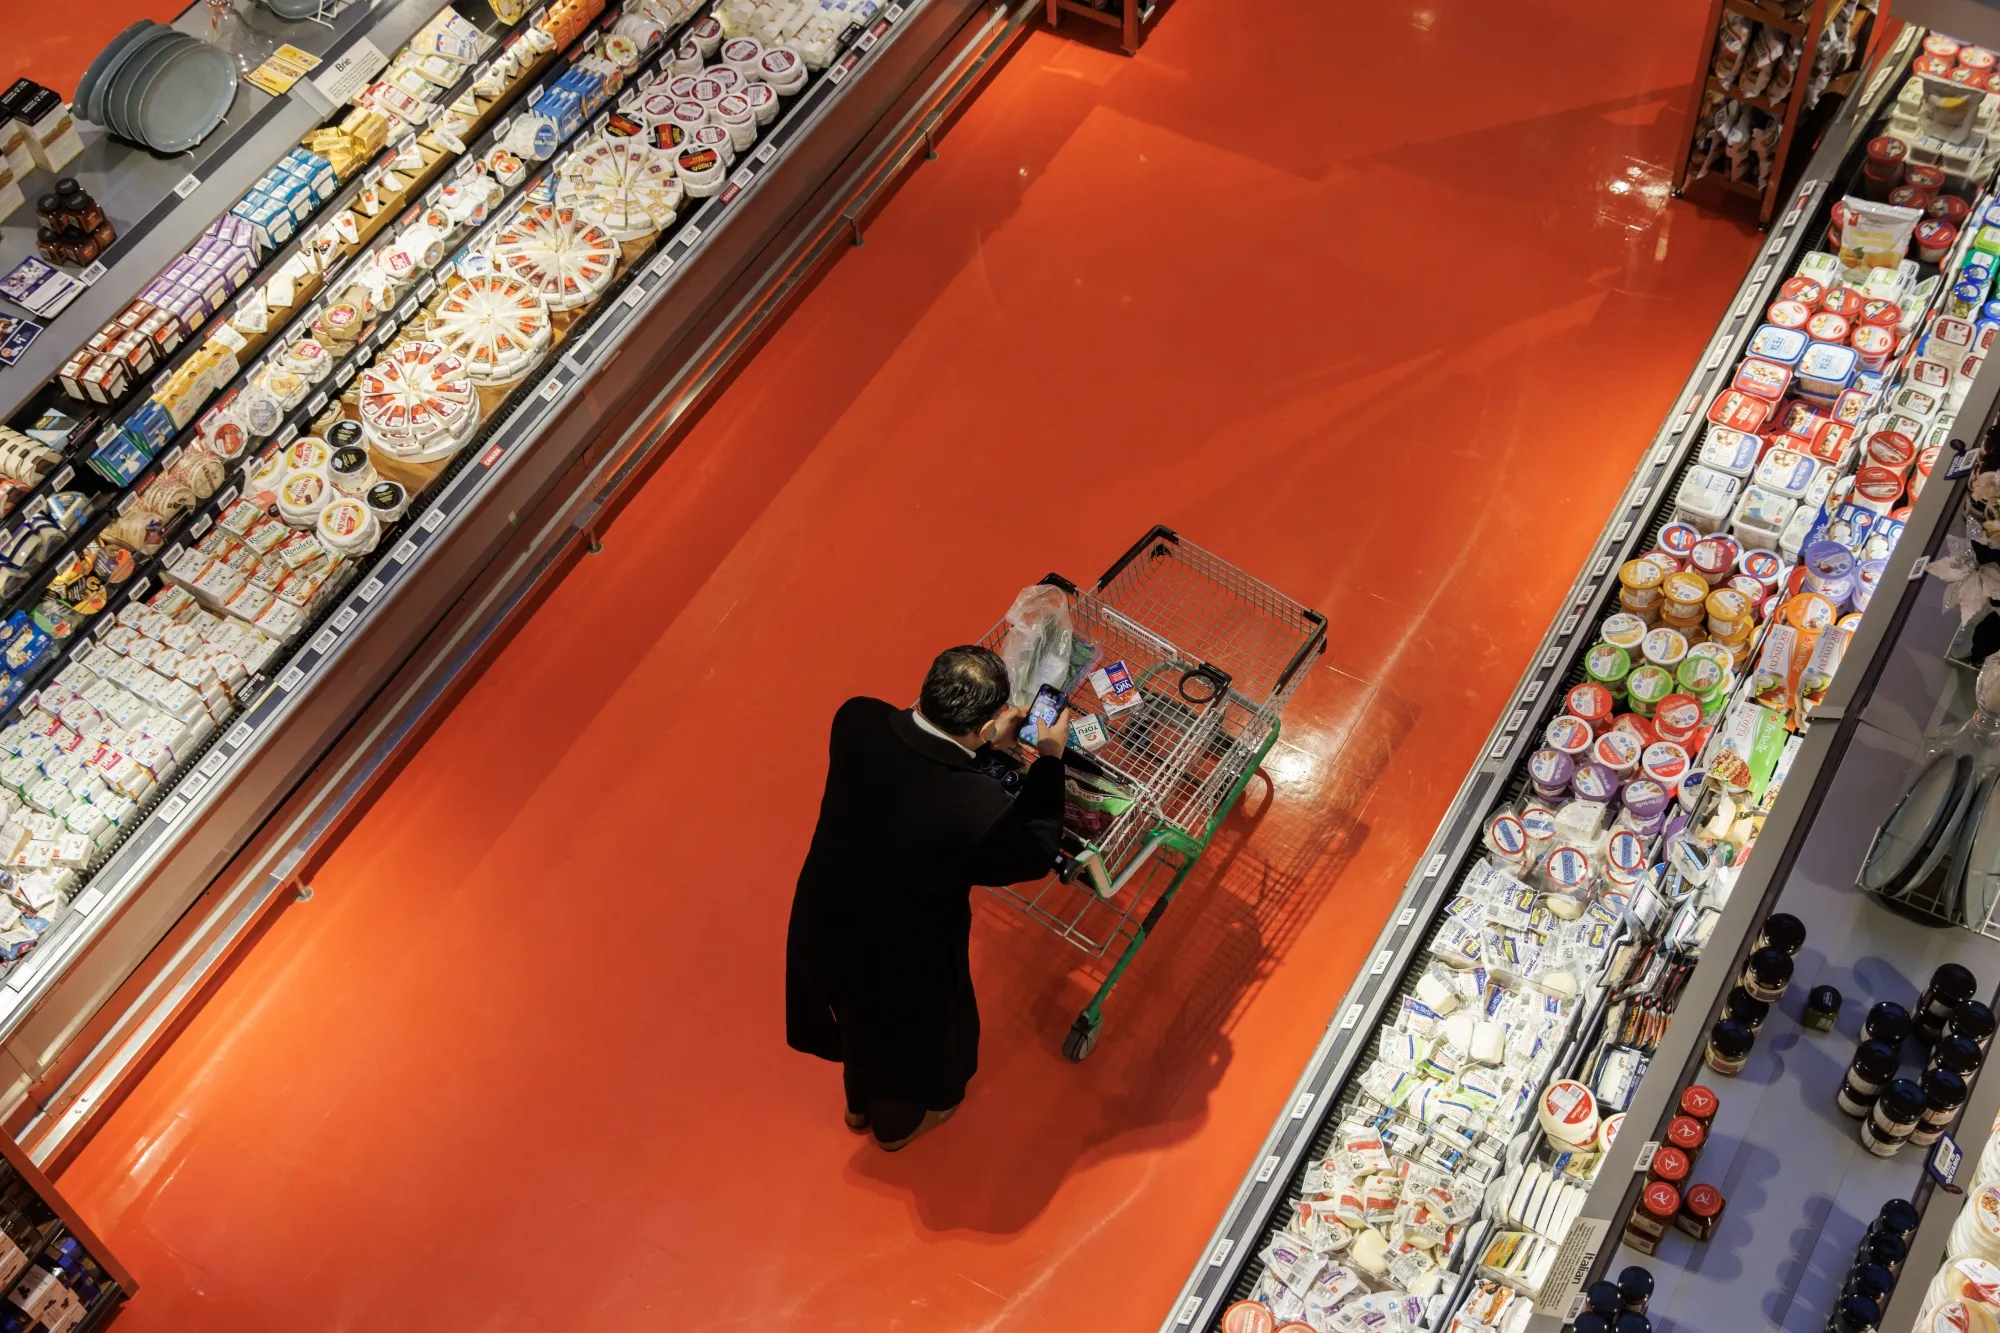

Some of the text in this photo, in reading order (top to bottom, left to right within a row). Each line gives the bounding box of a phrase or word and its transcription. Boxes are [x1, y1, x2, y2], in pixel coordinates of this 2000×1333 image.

[335, 56, 352, 72] Brie
[722, 185, 739, 202] CANADA
[1769, 337, 1784, 350] FETA
[1819, 355, 1833, 370] FETA
[483, 446, 503, 467] CANADA
[1814, 524, 1826, 542] Stelle
[1769, 630, 1790, 671] BOCCONCINI
[1818, 629, 1838, 671] BOCCONCINI
[1793, 654, 1807, 672] Stelle
[1078, 724, 1098, 735] TOFU
[1737, 708, 1756, 736] RICOTTA
[1756, 734, 1770, 753] Stelle
[1569, 1251, 1597, 1286] Italian
